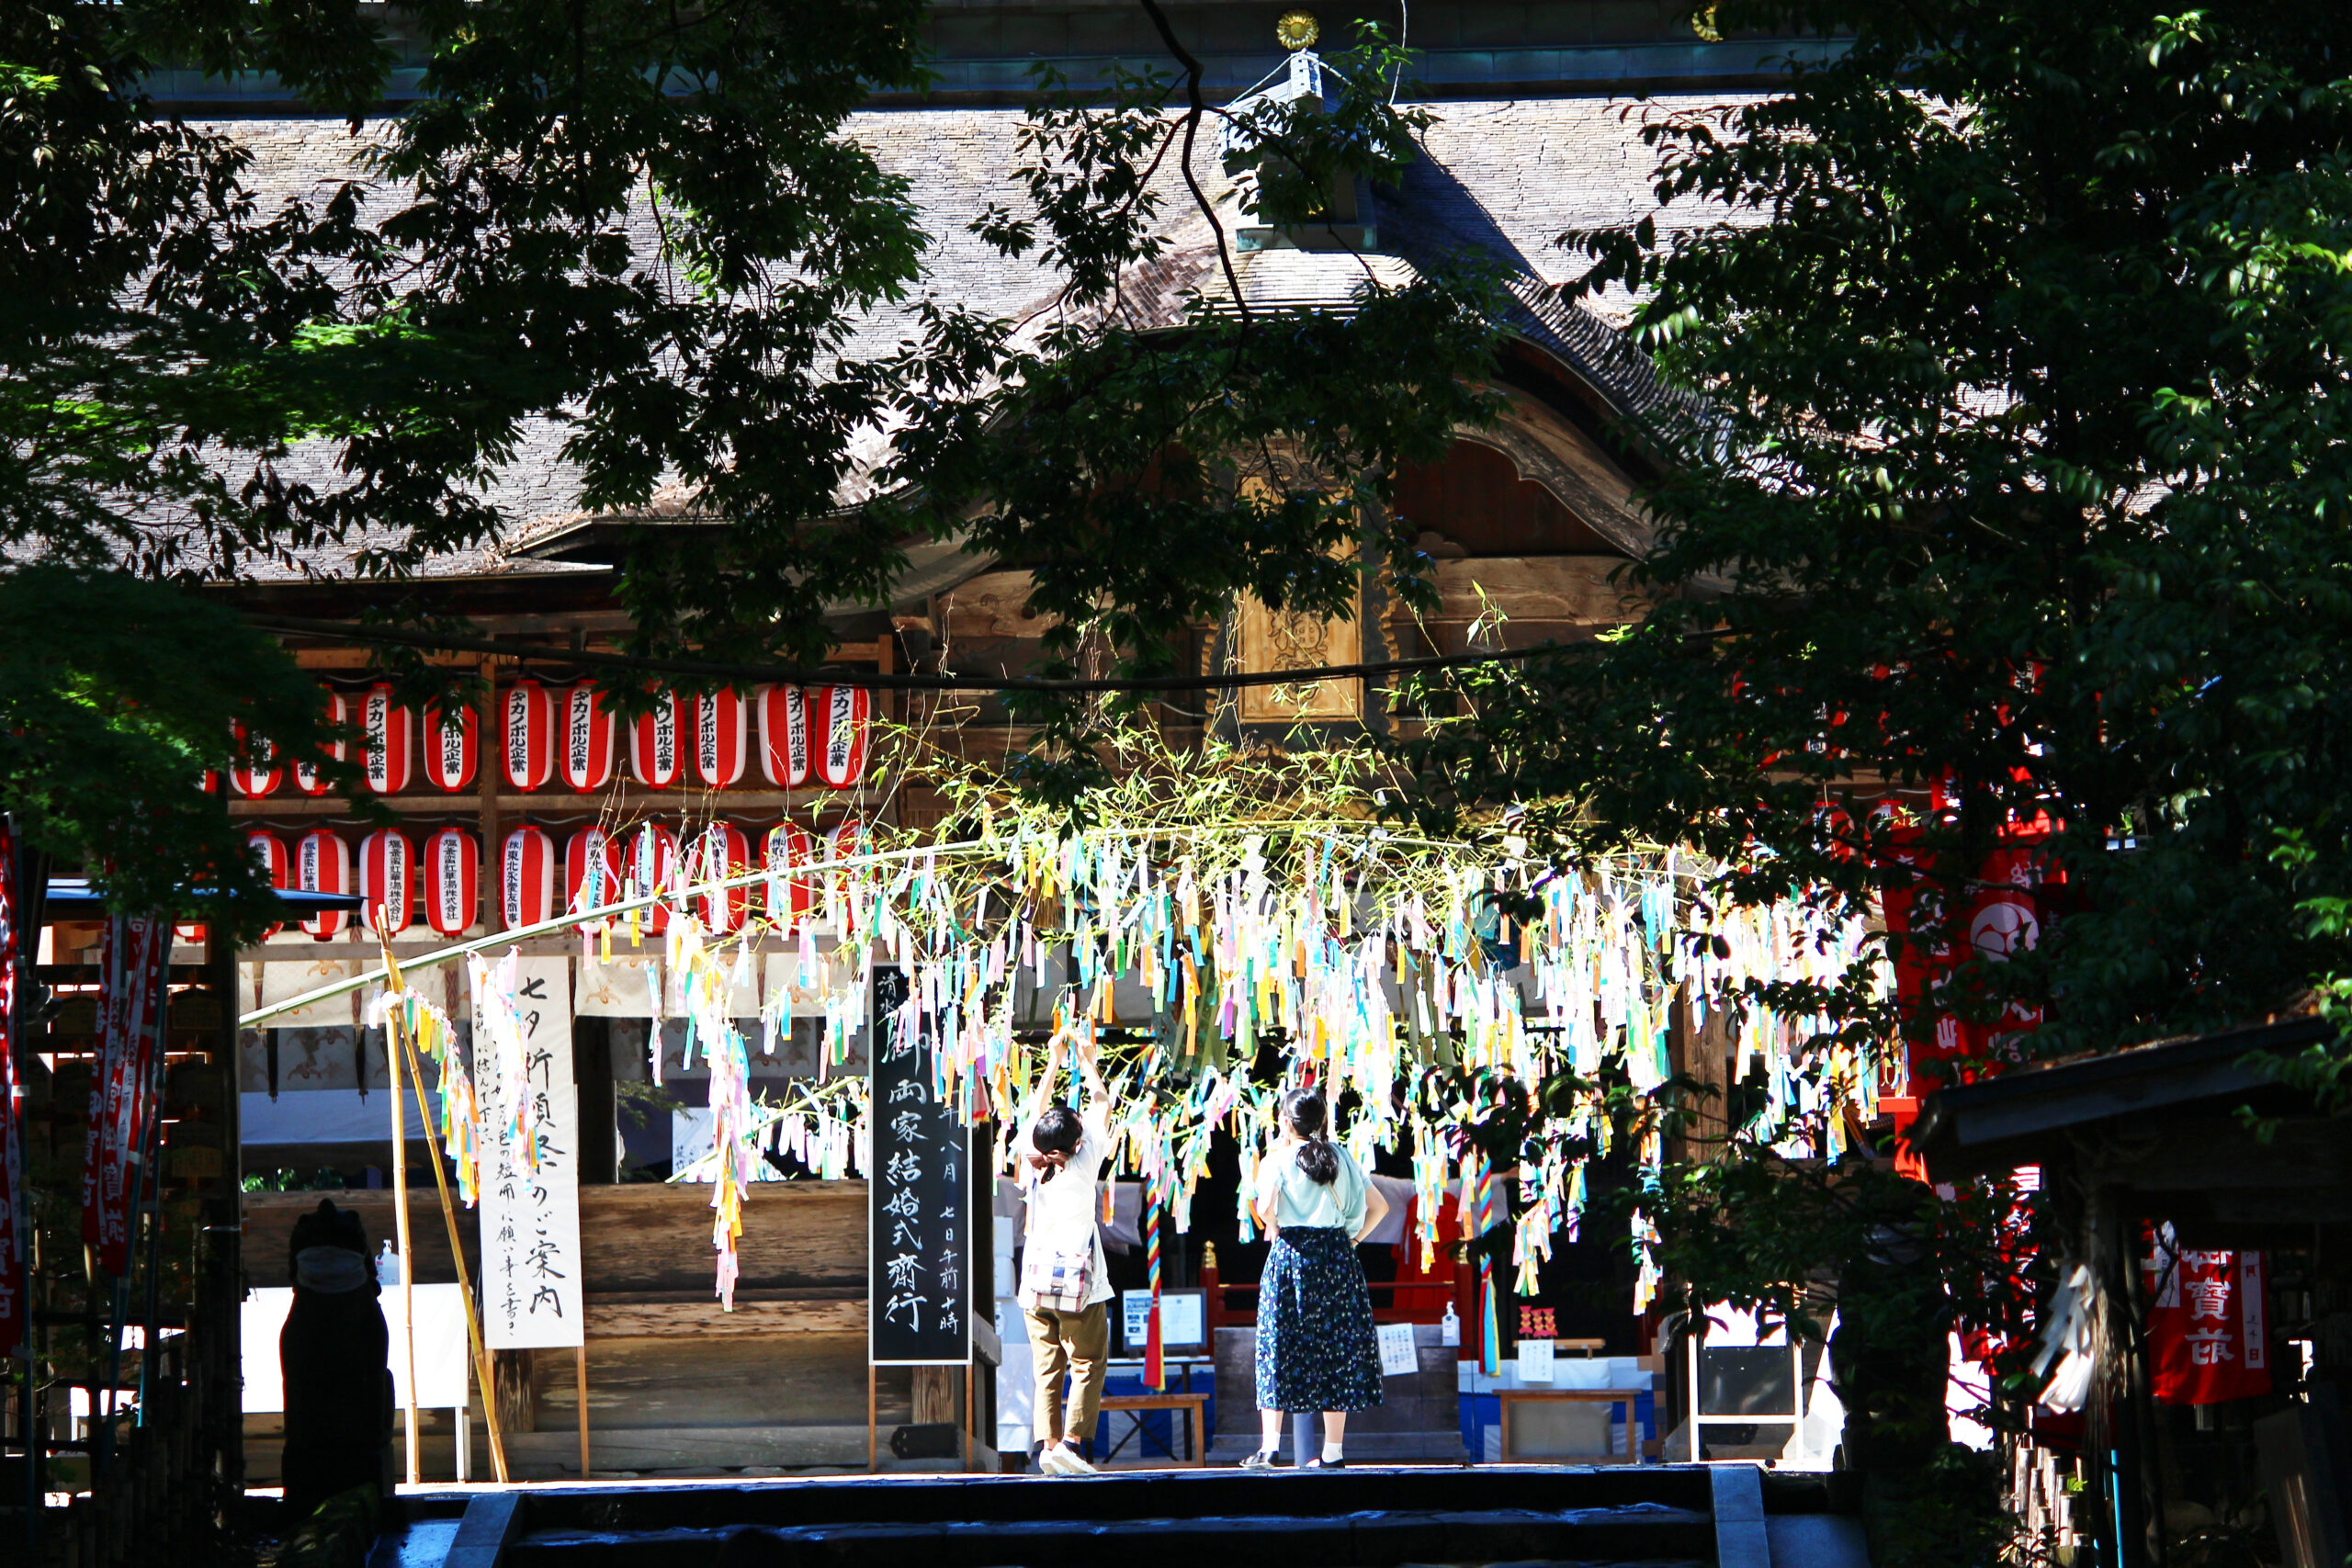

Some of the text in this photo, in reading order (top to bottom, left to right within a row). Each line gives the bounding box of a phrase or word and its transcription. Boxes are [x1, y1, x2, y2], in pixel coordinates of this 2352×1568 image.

[509, 691, 527, 773] タカノボル企業
[571, 690, 590, 772] タカノボル企業
